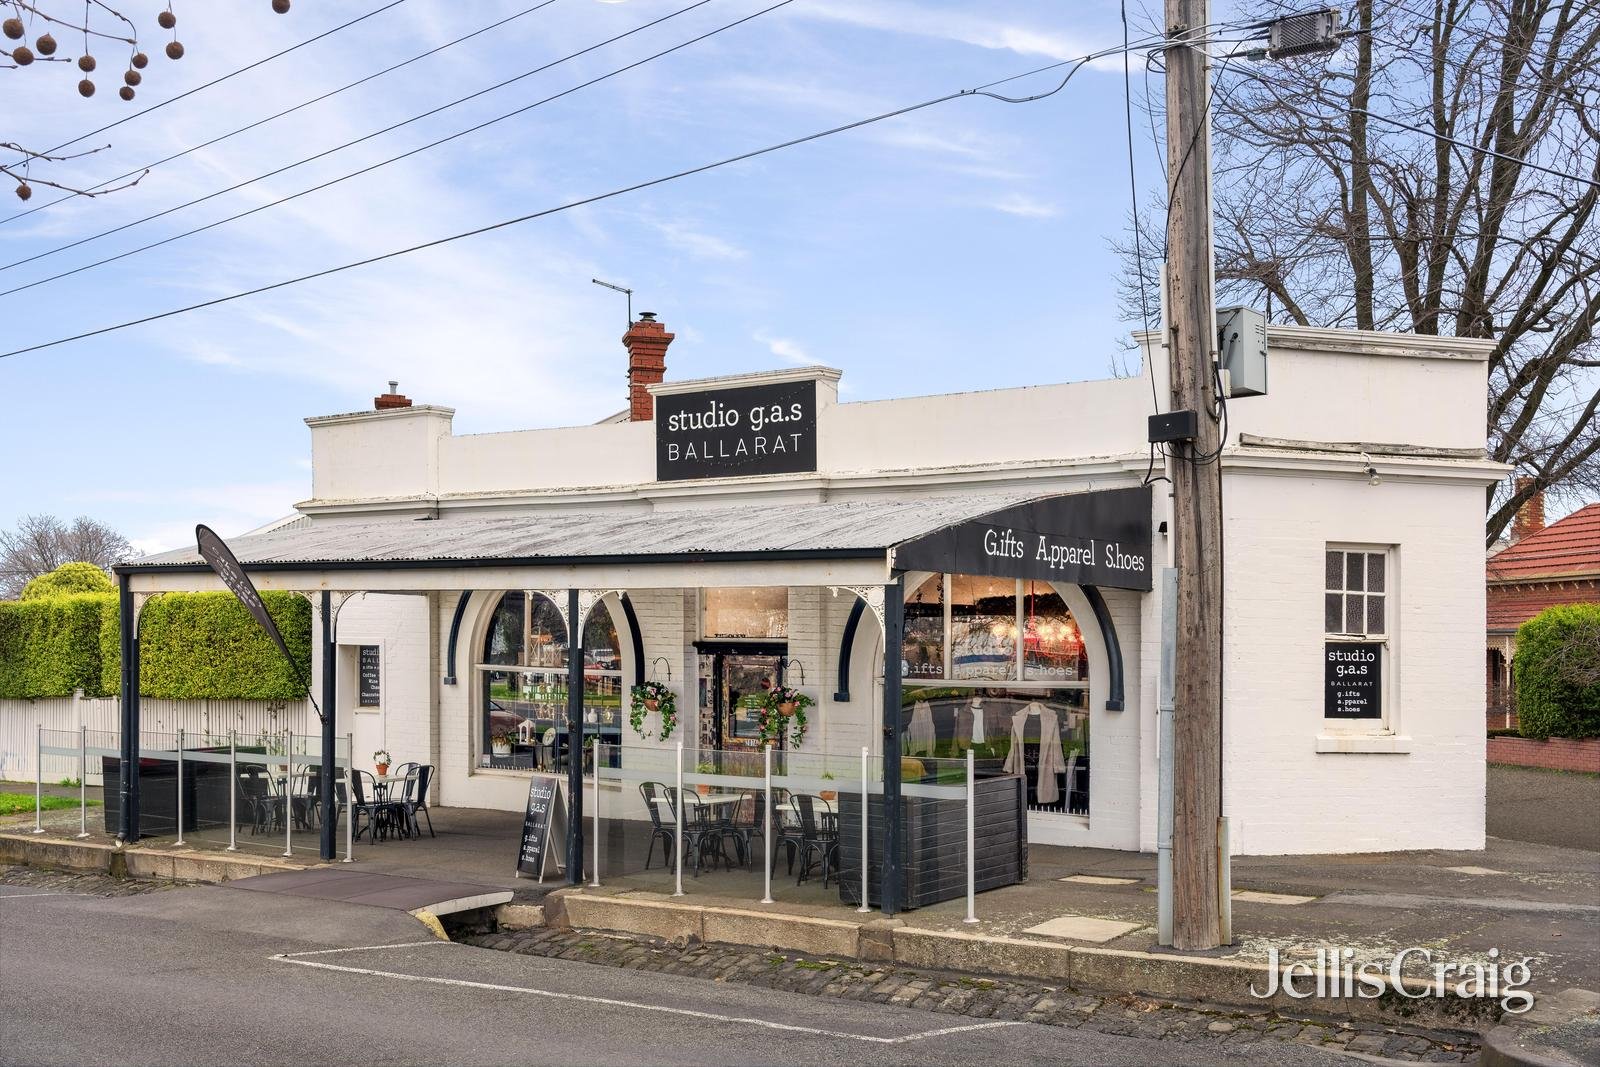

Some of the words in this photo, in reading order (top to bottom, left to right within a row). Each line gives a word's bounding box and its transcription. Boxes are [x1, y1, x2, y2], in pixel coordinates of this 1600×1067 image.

[668, 401, 739, 431] studio
[750, 403, 802, 431] g.a.s
[668, 434, 802, 461] BALLARAT
[984, 529, 1024, 559] G.ifts
[1036, 535, 1096, 569] A.pparel
[1105, 543, 1145, 572] S.hoes
[1328, 649, 1375, 662] studio
[1336, 664, 1368, 677] g.a.s
[1337, 690, 1360, 698] g.ifts
[1337, 698, 1368, 706] a.pparel
[529, 786, 551, 800] studio
